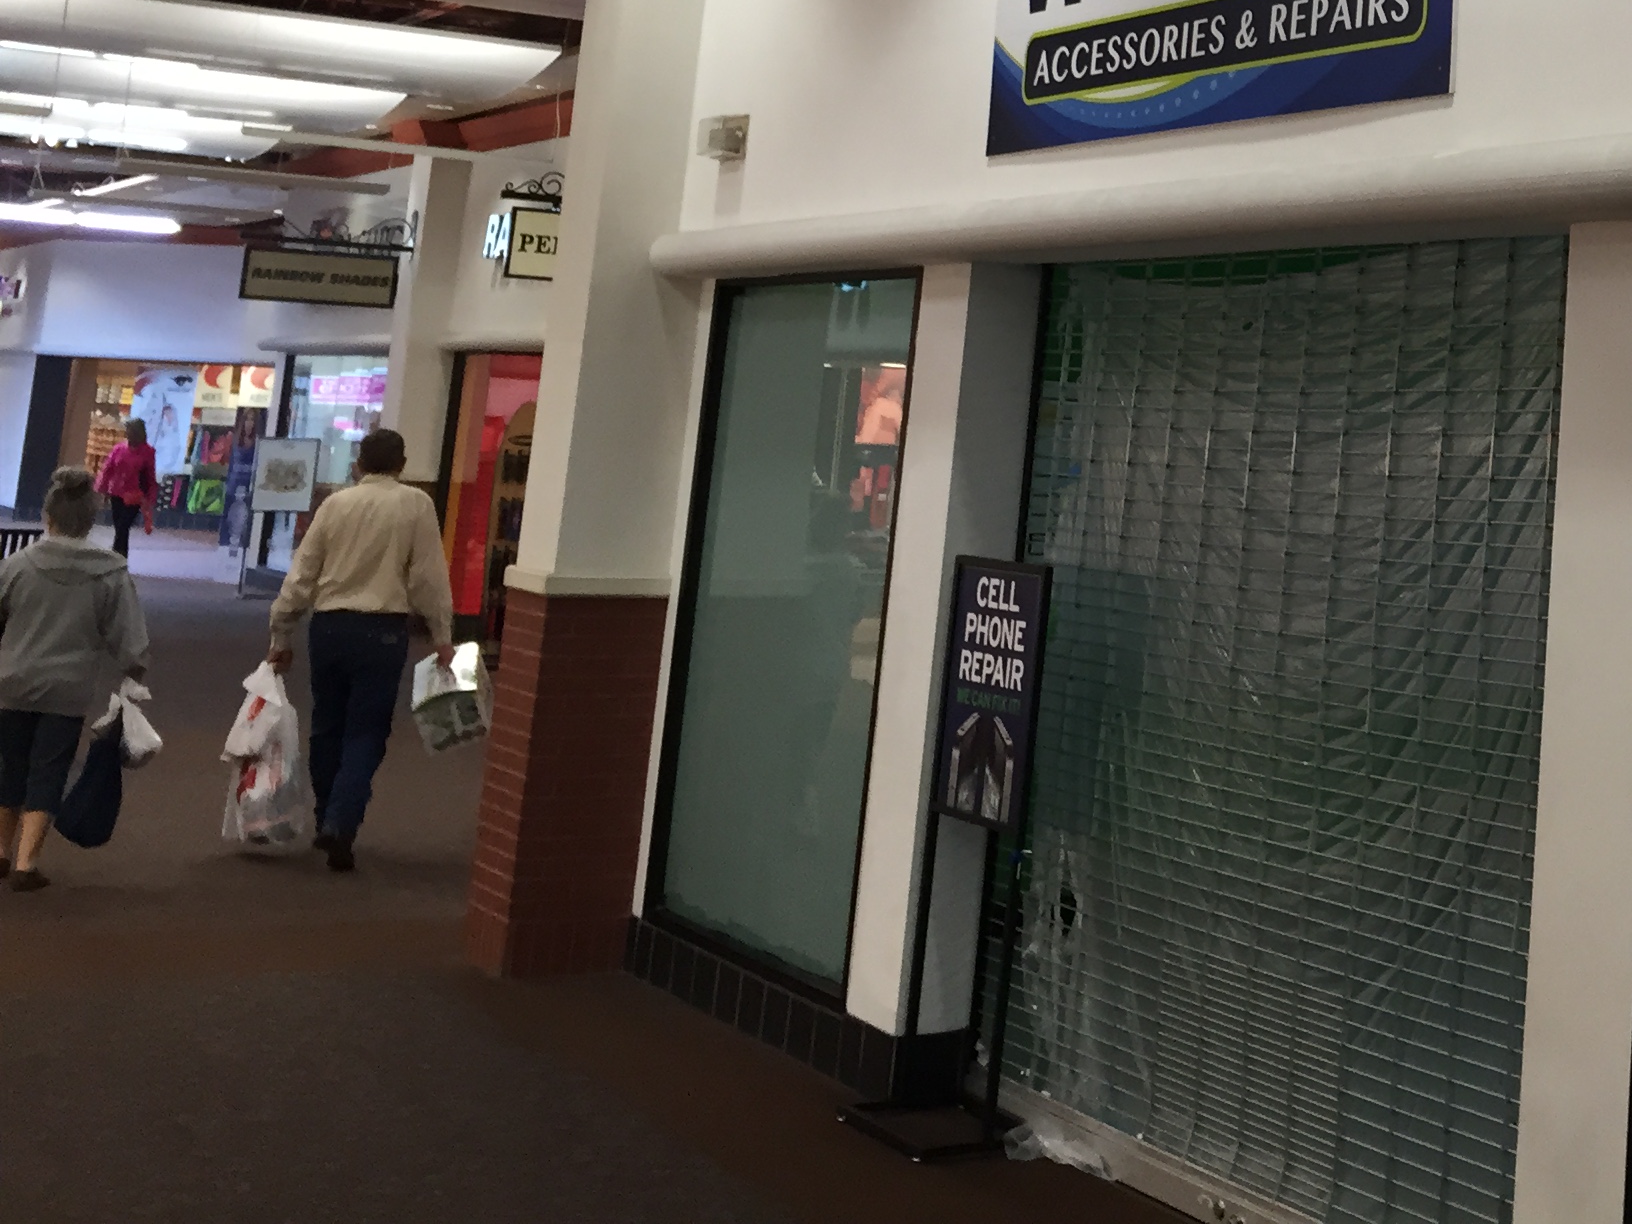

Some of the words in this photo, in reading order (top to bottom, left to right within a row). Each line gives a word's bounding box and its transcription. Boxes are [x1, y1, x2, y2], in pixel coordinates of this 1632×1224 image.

[1033, 15, 1225, 87] ACCESSORIES
[1235, 9, 1258, 50] &
[252, 267, 325, 284] RAINBOW
[329, 273, 390, 287] SHADES
[976, 576, 1020, 613] CELL
[964, 612, 1027, 653] PHONE
[959, 649, 1025, 692] REPAIR
